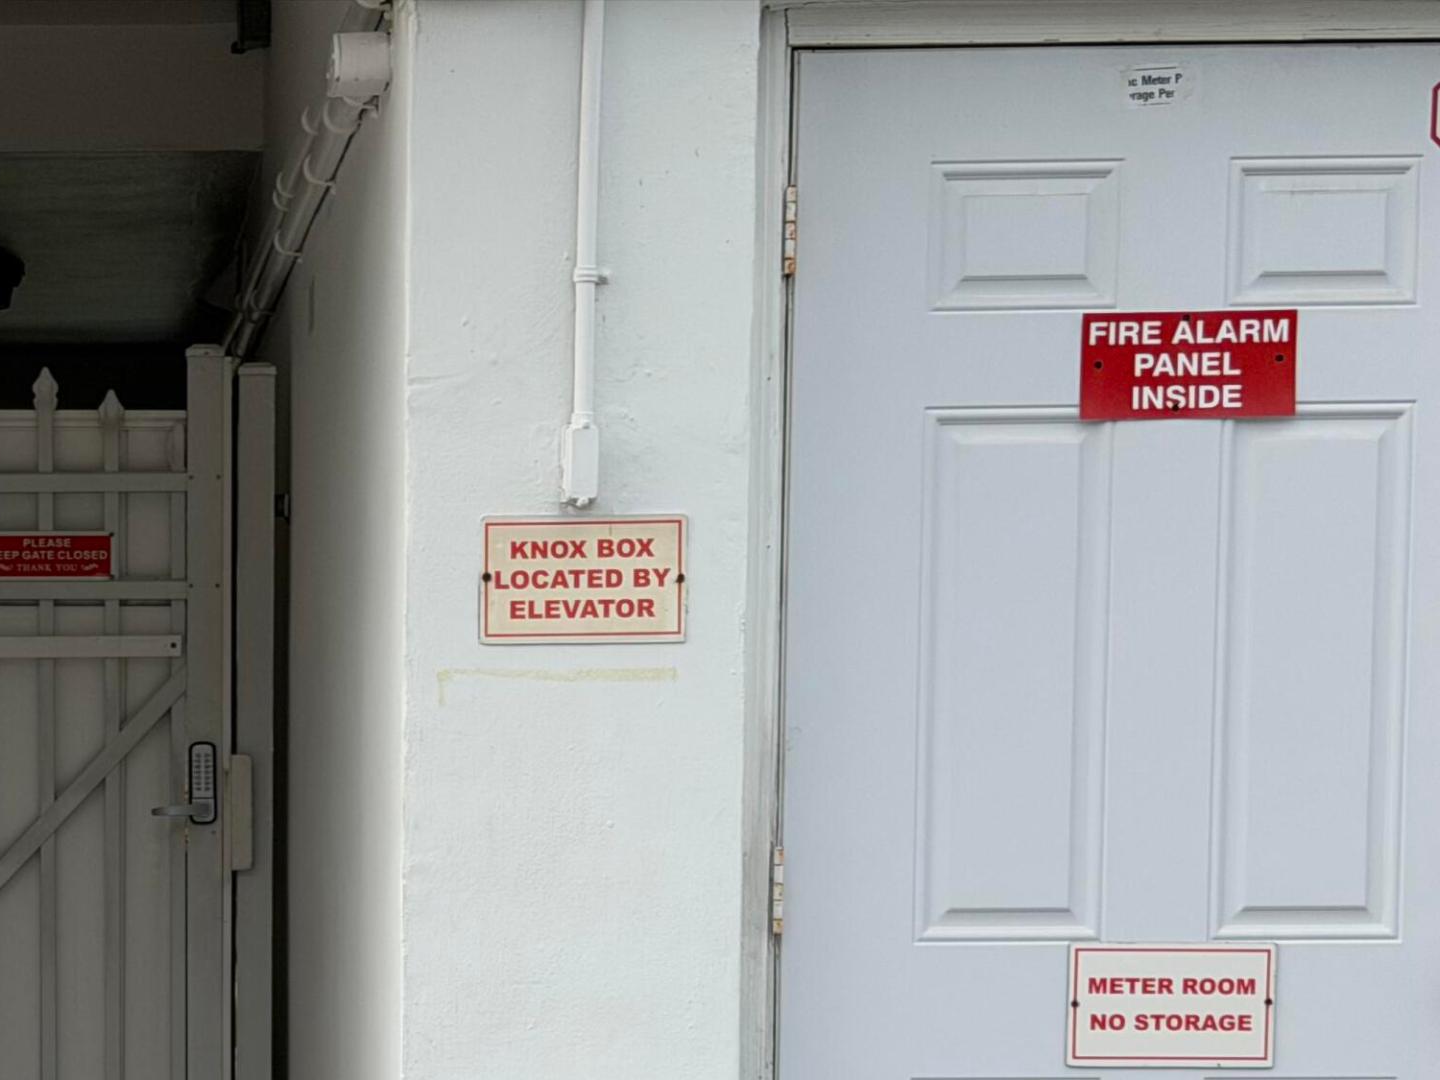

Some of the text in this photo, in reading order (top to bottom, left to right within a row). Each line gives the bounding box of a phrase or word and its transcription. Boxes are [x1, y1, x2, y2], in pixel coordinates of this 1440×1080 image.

[1141, 75, 1172, 86] Meter
[1088, 318, 1290, 346] FIRE ALARM
[1134, 351, 1242, 377] PANEL
[1132, 384, 1243, 410] INSIDE
[22, 538, 71, 548] PLEASE
[510, 537, 655, 560] KNOX BOX
[22, 550, 55, 560] GATE
[57, 550, 108, 560] CLOSED
[17, 563, 79, 572] THANK YOU
[494, 567, 671, 590] LOCATED BY
[509, 598, 656, 619] ELEVATOR
[1088, 977, 1257, 995] METER ROOM
[1090, 1014, 1253, 1031] NO STORAGE
